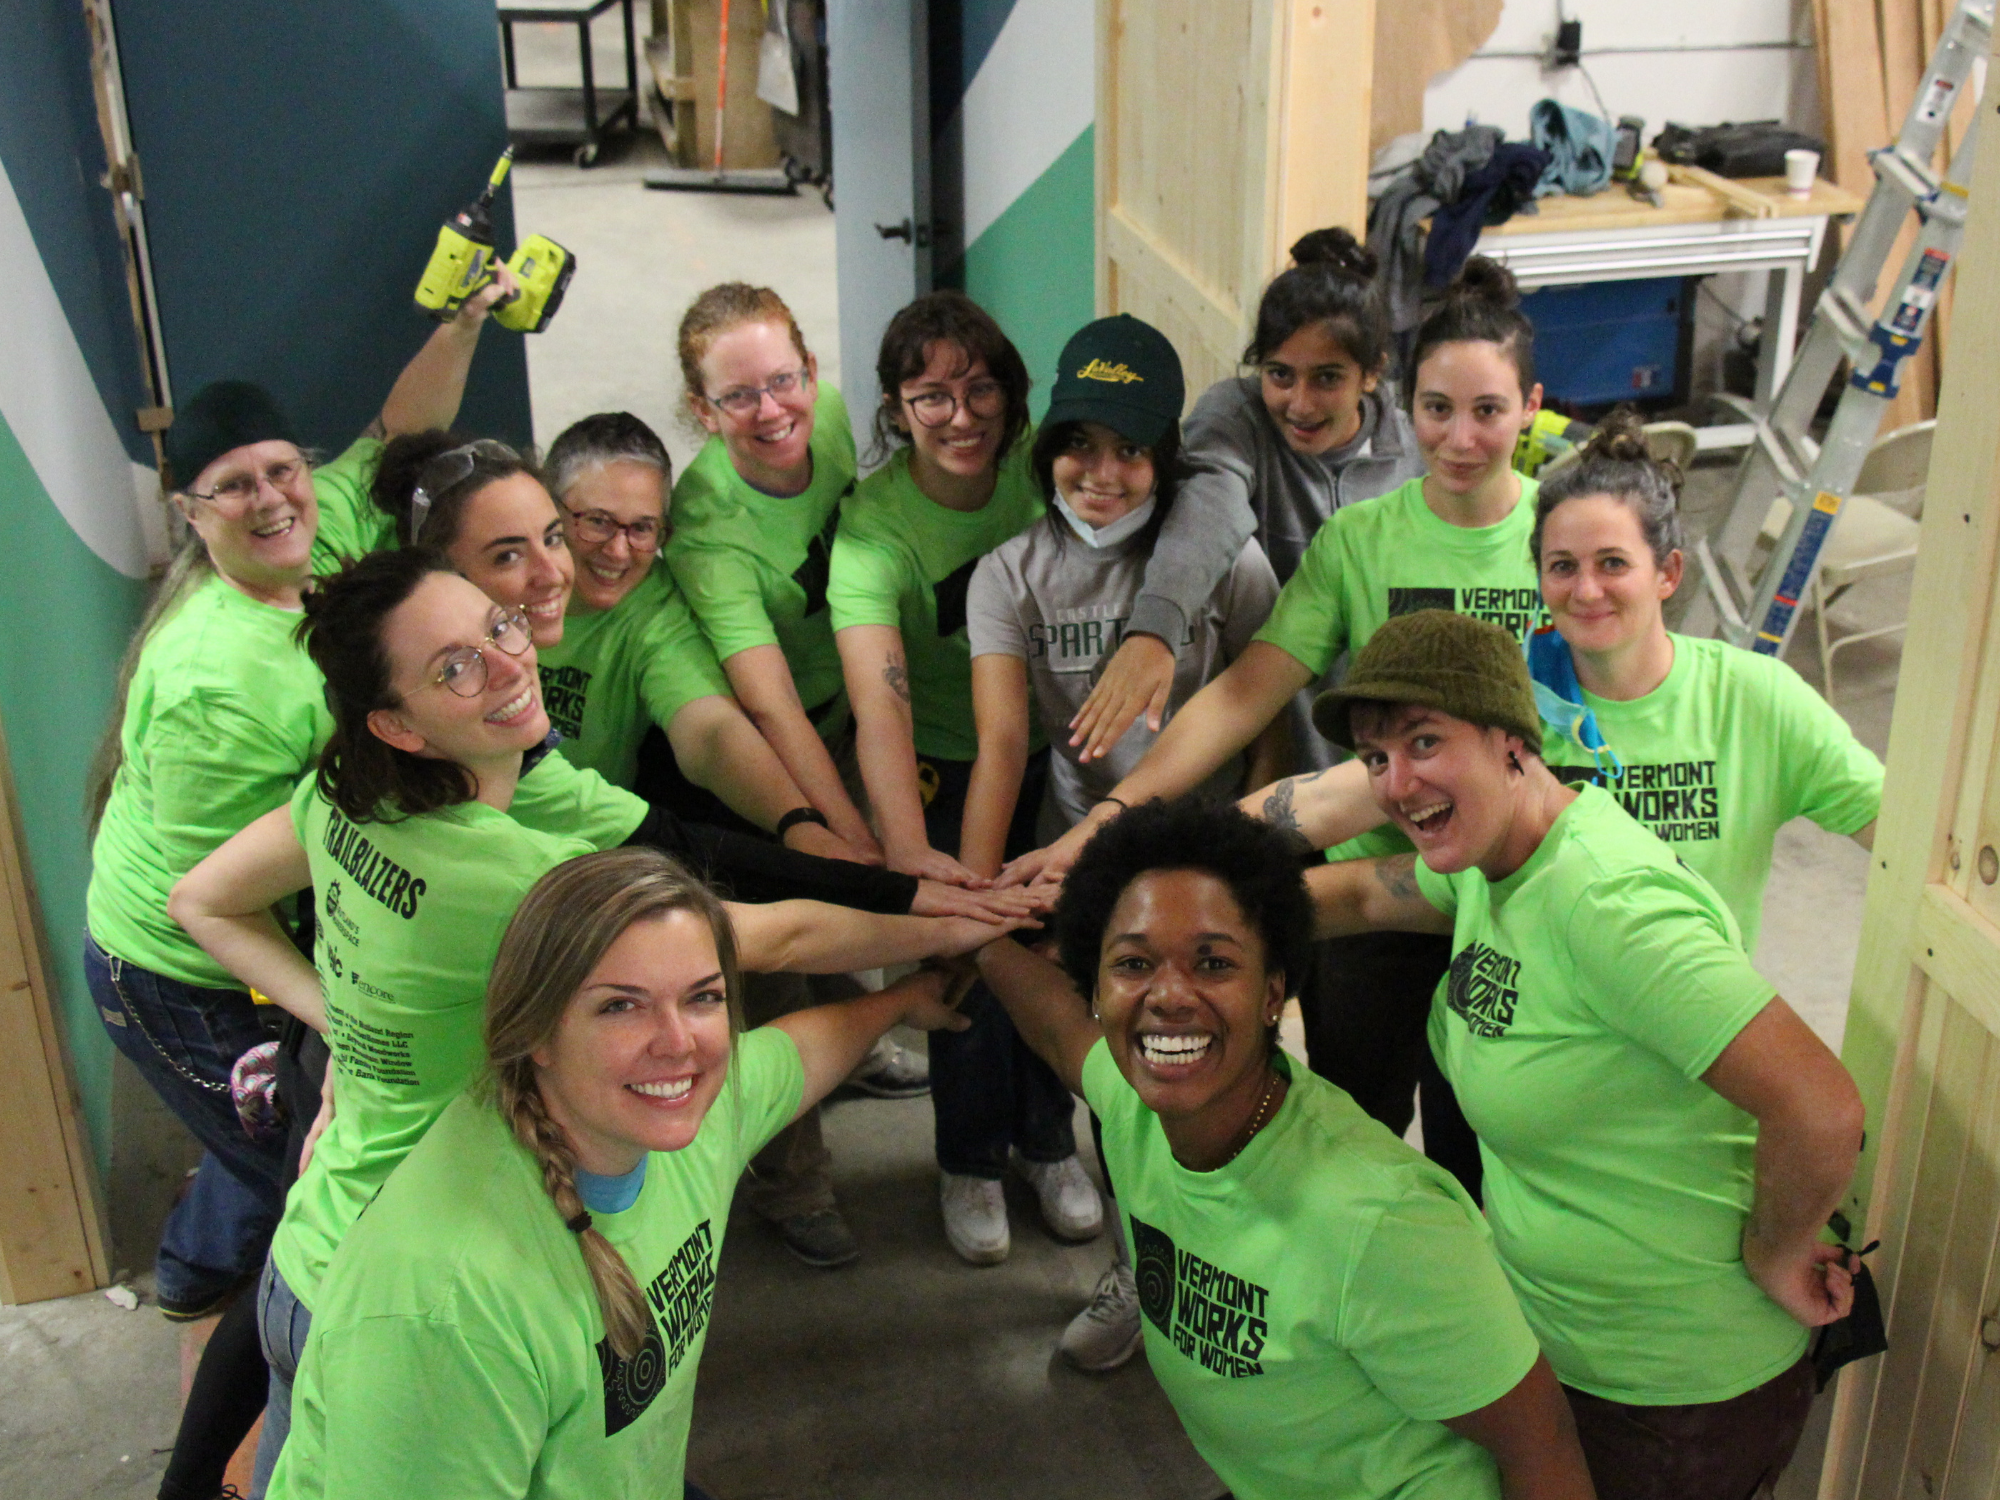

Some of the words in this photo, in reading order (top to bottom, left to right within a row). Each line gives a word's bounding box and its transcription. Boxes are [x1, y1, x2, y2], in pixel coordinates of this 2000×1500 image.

[1462, 588, 1549, 610] VERMON
[541, 686, 586, 723] RKS
[1613, 760, 1717, 789] VERMONT
[1614, 787, 1718, 820] WORKS
[1655, 821, 1720, 842] WOMEN
[323, 805, 426, 920] TRAILBLAZERS
[647, 1218, 713, 1314] VERMONT
[1177, 1248, 1269, 1318] VERMONT
[668, 1338, 686, 1378] FOR
[686, 1288, 714, 1347] WOME
[1177, 1281, 1268, 1361] WORKS
[1173, 1323, 1197, 1361] FOR
[1200, 1340, 1265, 1379] WOMEN
